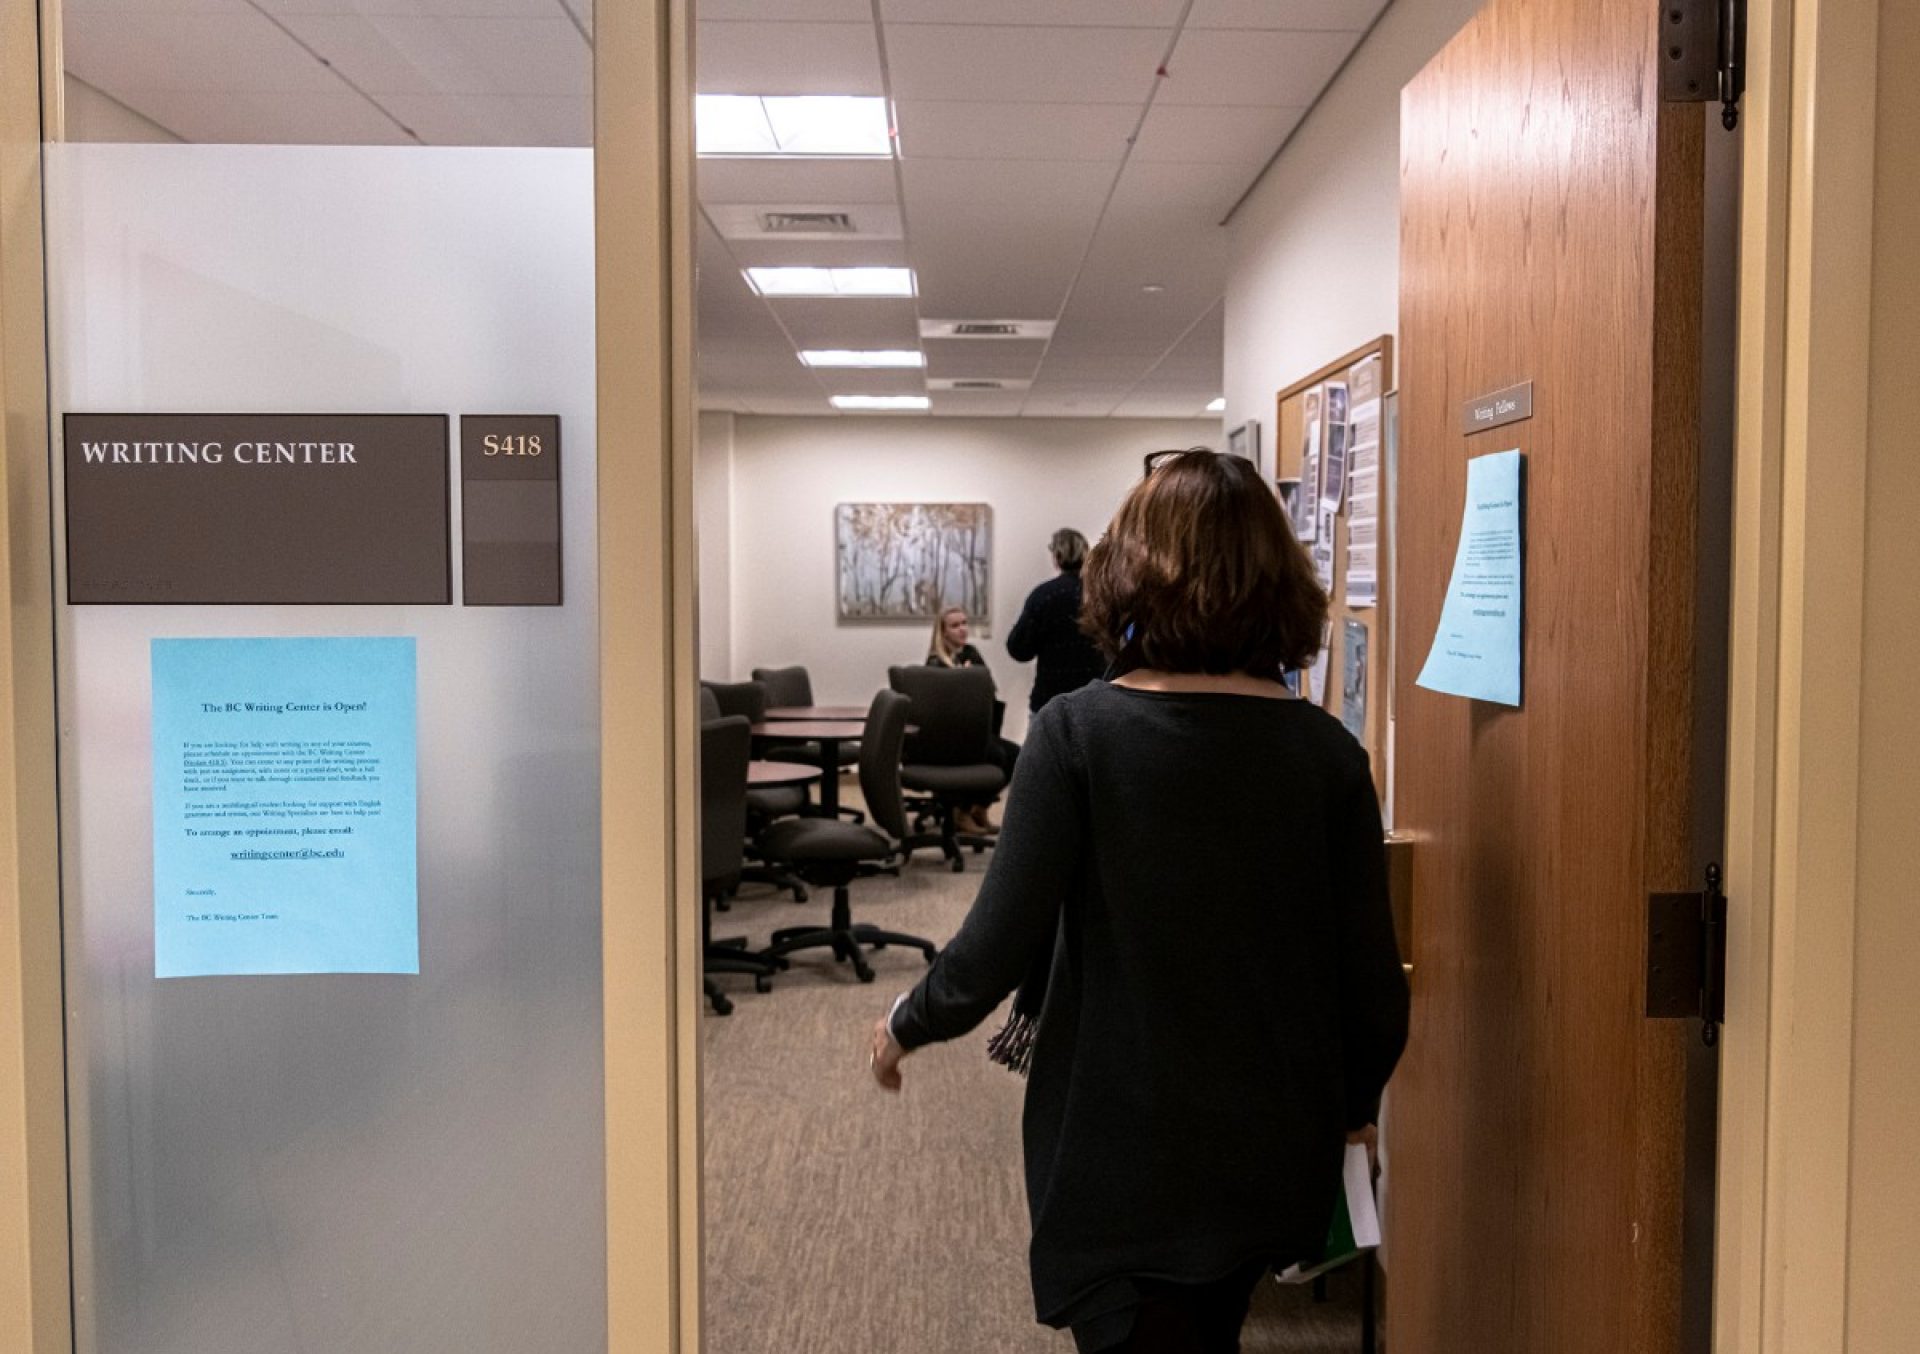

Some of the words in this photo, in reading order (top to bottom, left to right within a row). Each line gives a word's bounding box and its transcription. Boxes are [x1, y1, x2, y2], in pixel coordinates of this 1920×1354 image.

[483, 435, 542, 456] S418
[81, 441, 223, 464] WRITING
[234, 441, 357, 464] CENTER
[202, 703, 222, 712] The
[225, 703, 241, 712] BC
[244, 703, 283, 713] Writing
[286, 702, 320, 711] Center
[323, 703, 332, 711] is
[335, 702, 367, 713] Open!
[200, 829, 230, 837] arrange
[301, 827, 326, 836] please
[230, 848, 344, 860] writingcenter@bc.edu
